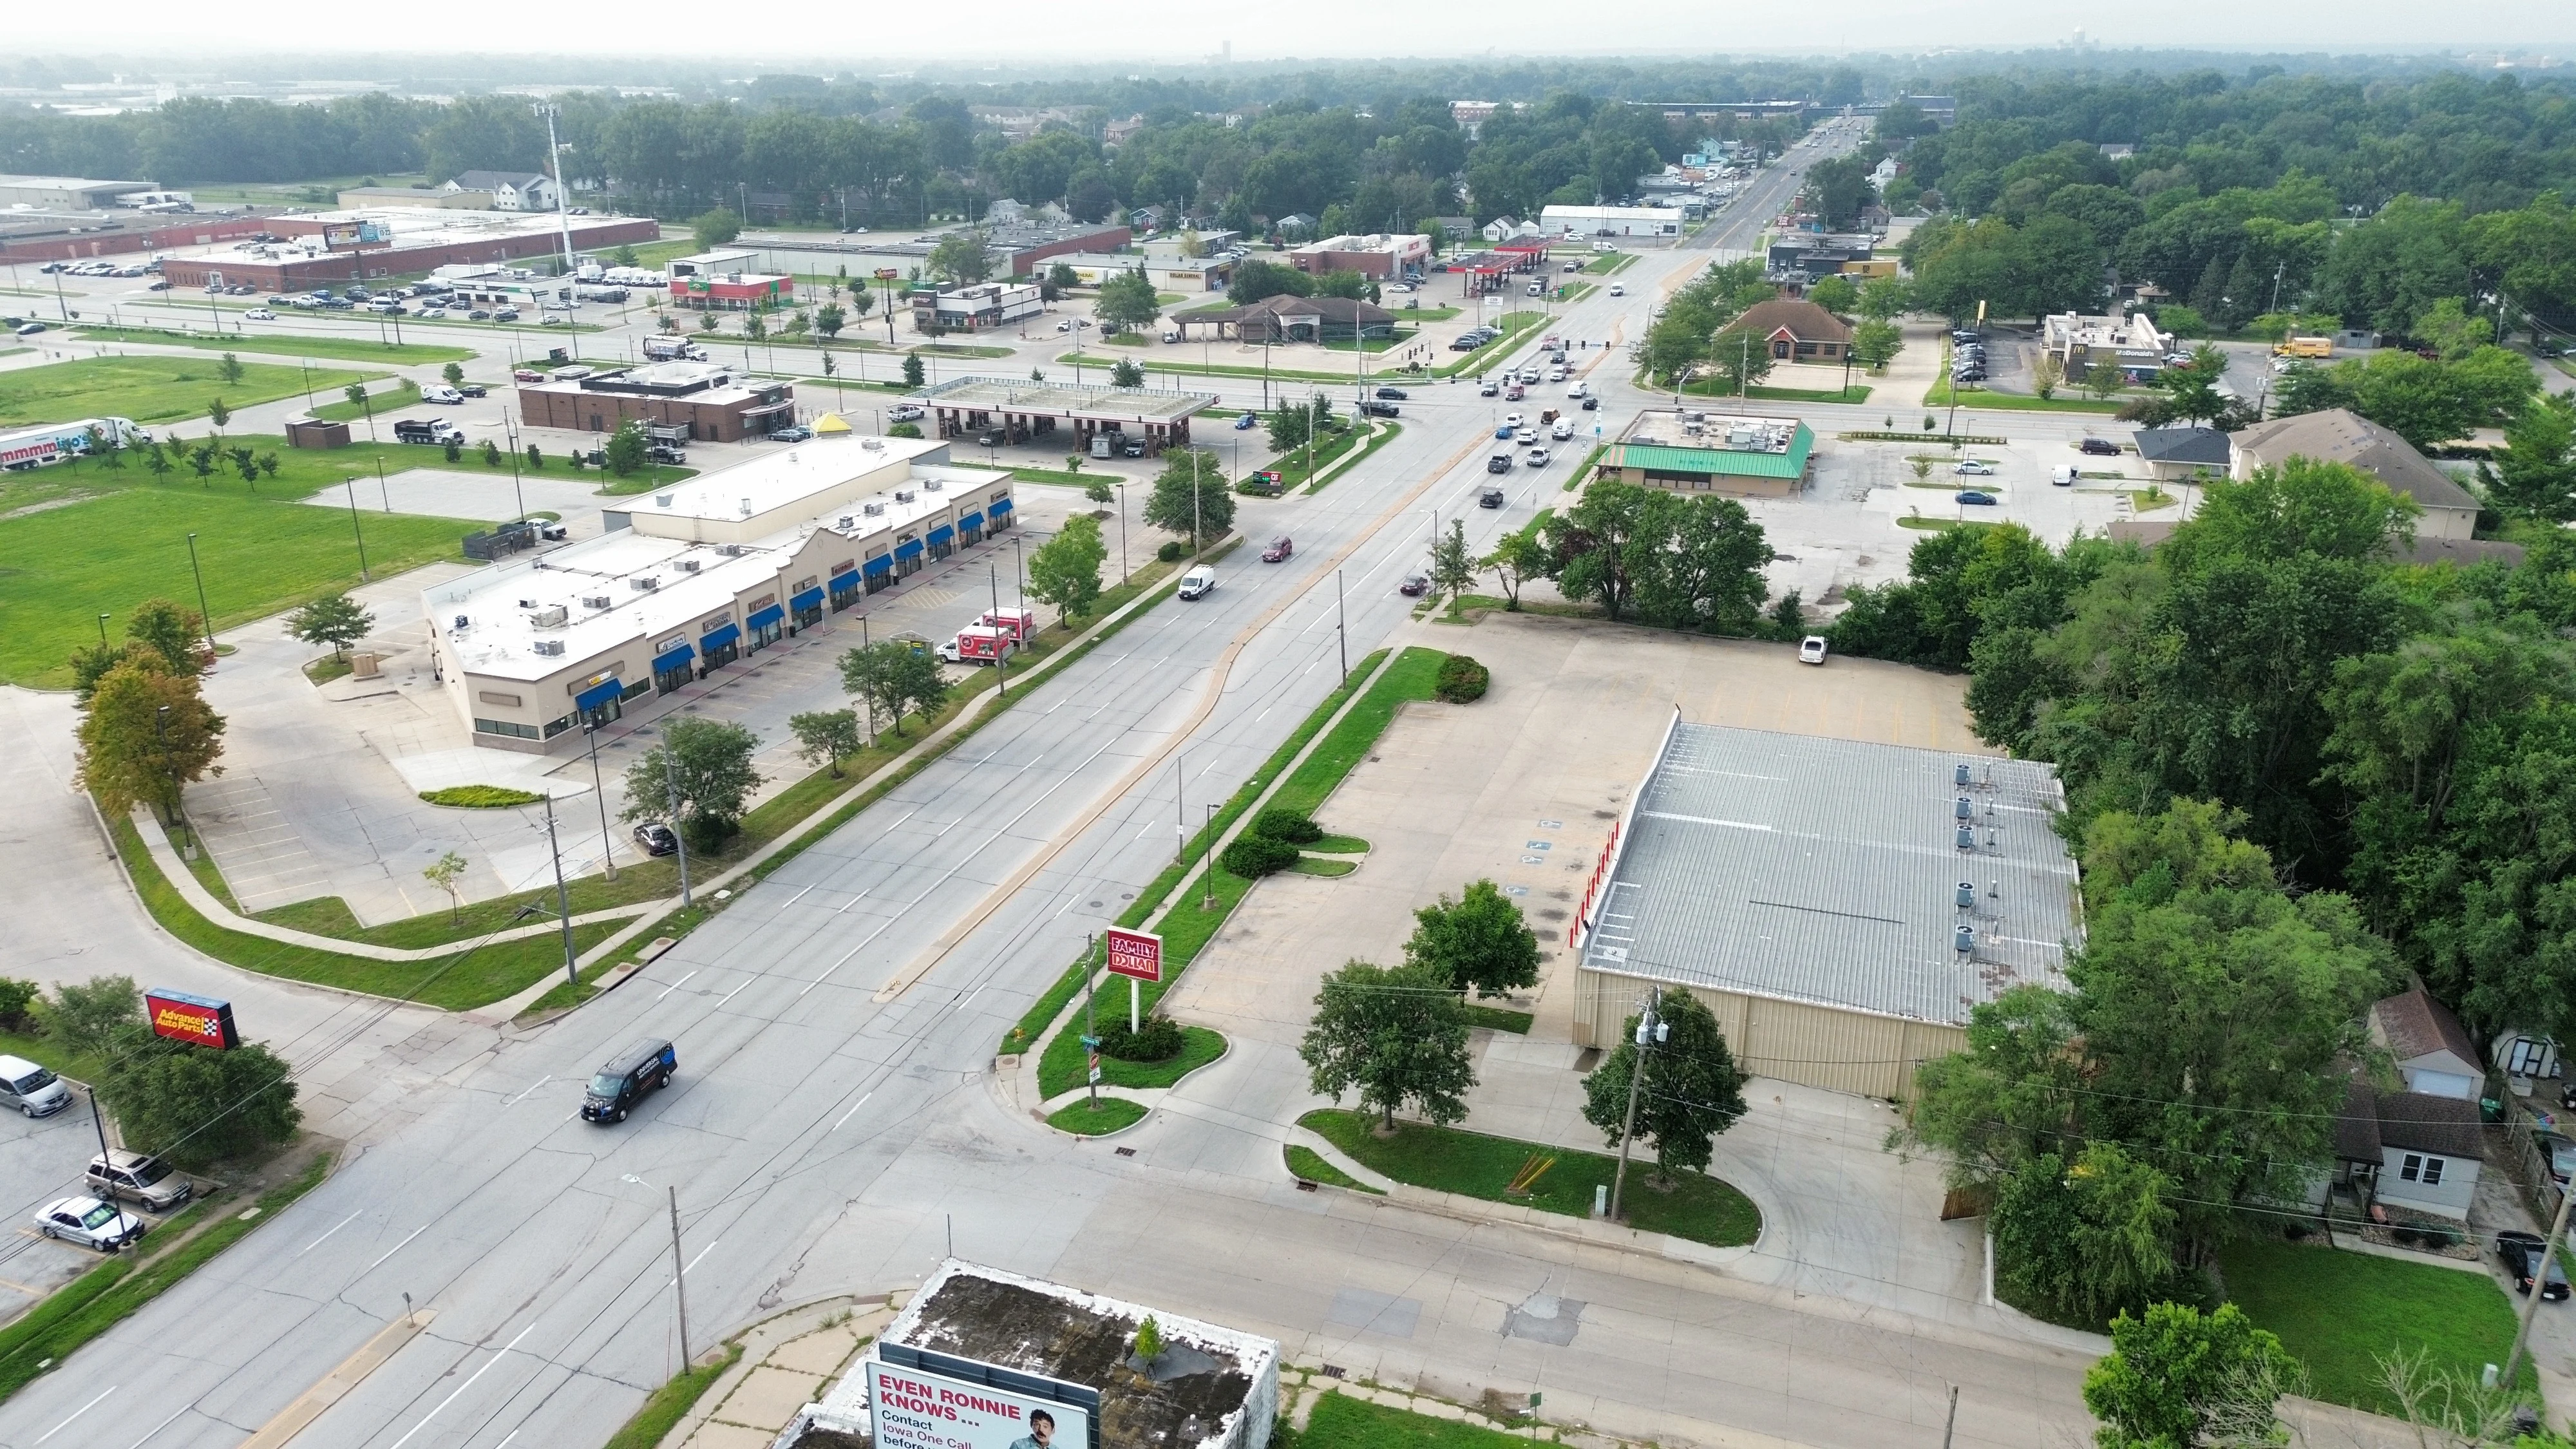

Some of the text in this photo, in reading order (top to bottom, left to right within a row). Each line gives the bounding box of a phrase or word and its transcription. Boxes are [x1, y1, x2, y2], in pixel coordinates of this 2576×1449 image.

[1112, 937, 1156, 958] FAMILY
[1112, 952, 1155, 973] DOLLAR
[156, 1017, 200, 1033] Auto Parts
[159, 1009, 201, 1025] Advance
[637, 1056, 659, 1075] UNIVERSAL
[879, 1374, 1021, 1420] EVEN RONNIE
[882, 1410, 933, 1431] Contact
[882, 1421, 971, 1449] Iowa One Call
